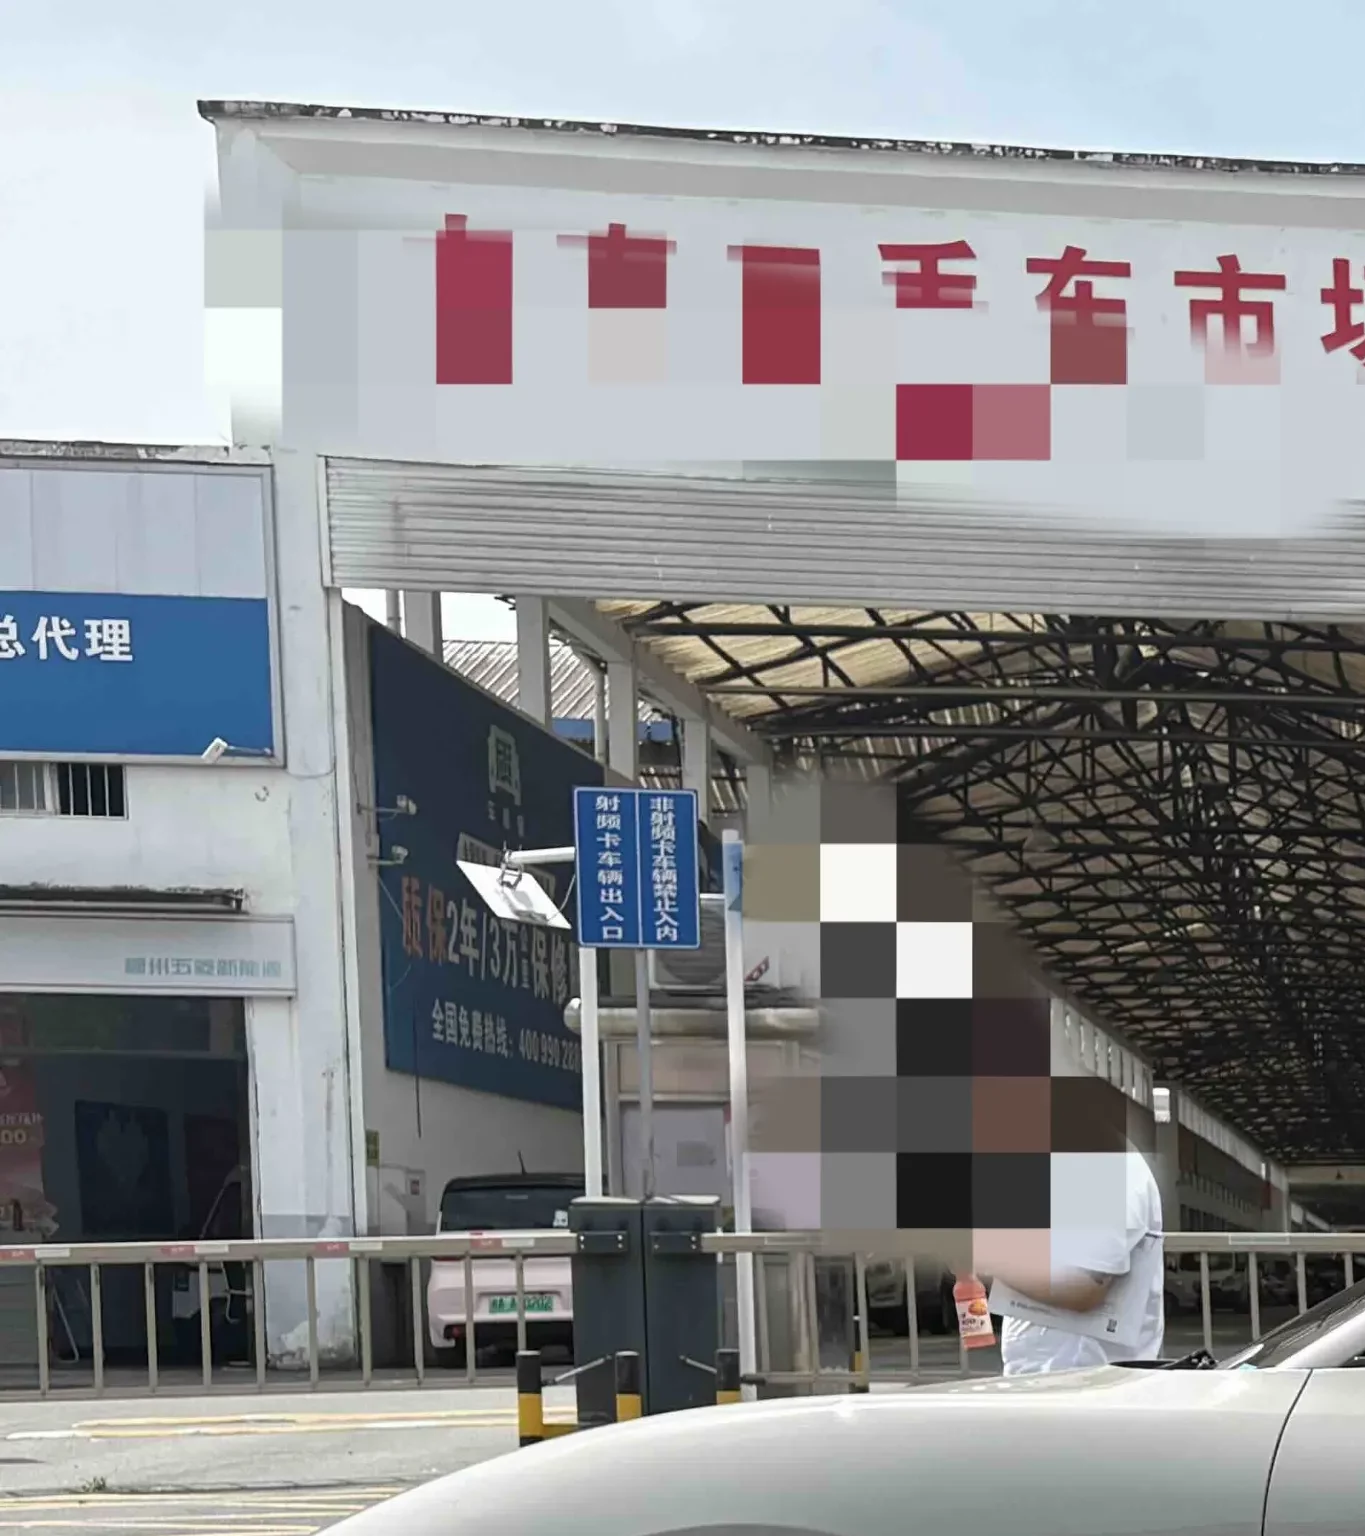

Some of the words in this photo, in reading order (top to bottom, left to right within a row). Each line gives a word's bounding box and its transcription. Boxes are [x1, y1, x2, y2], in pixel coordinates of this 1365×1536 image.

[595, 796, 624, 940] 射频卡车辆出入口
[650, 797, 679, 941] 非射频卡车辆禁止入内
